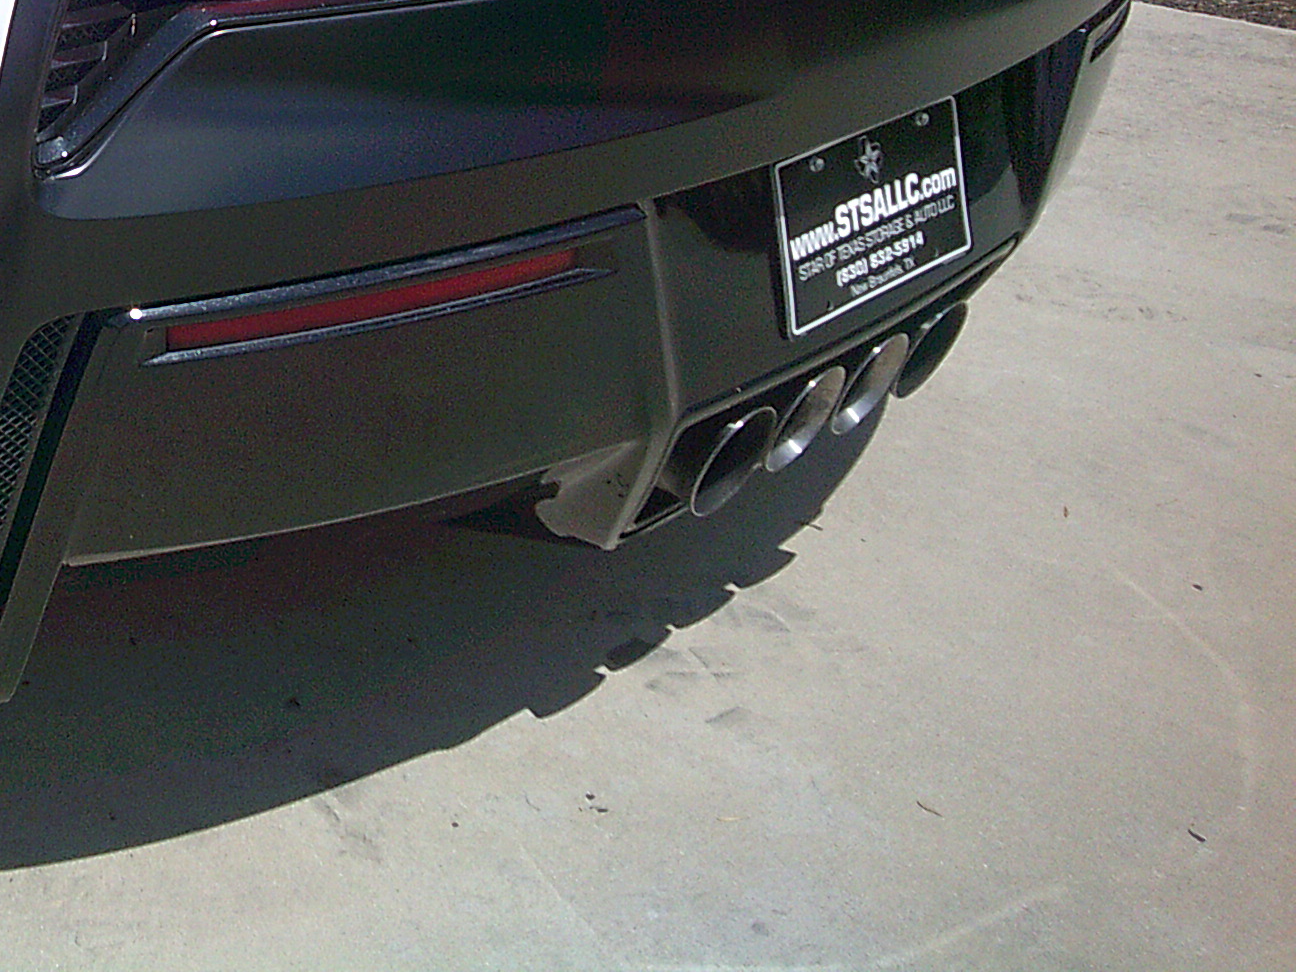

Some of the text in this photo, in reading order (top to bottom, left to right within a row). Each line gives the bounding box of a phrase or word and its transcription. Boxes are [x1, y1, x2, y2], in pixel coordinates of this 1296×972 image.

[789, 166, 957, 261] www.STSALLC.com
[798, 194, 956, 281] STAR OF TEXAS STORAGE & AUTO LLC
[836, 257, 868, 287] (830)
